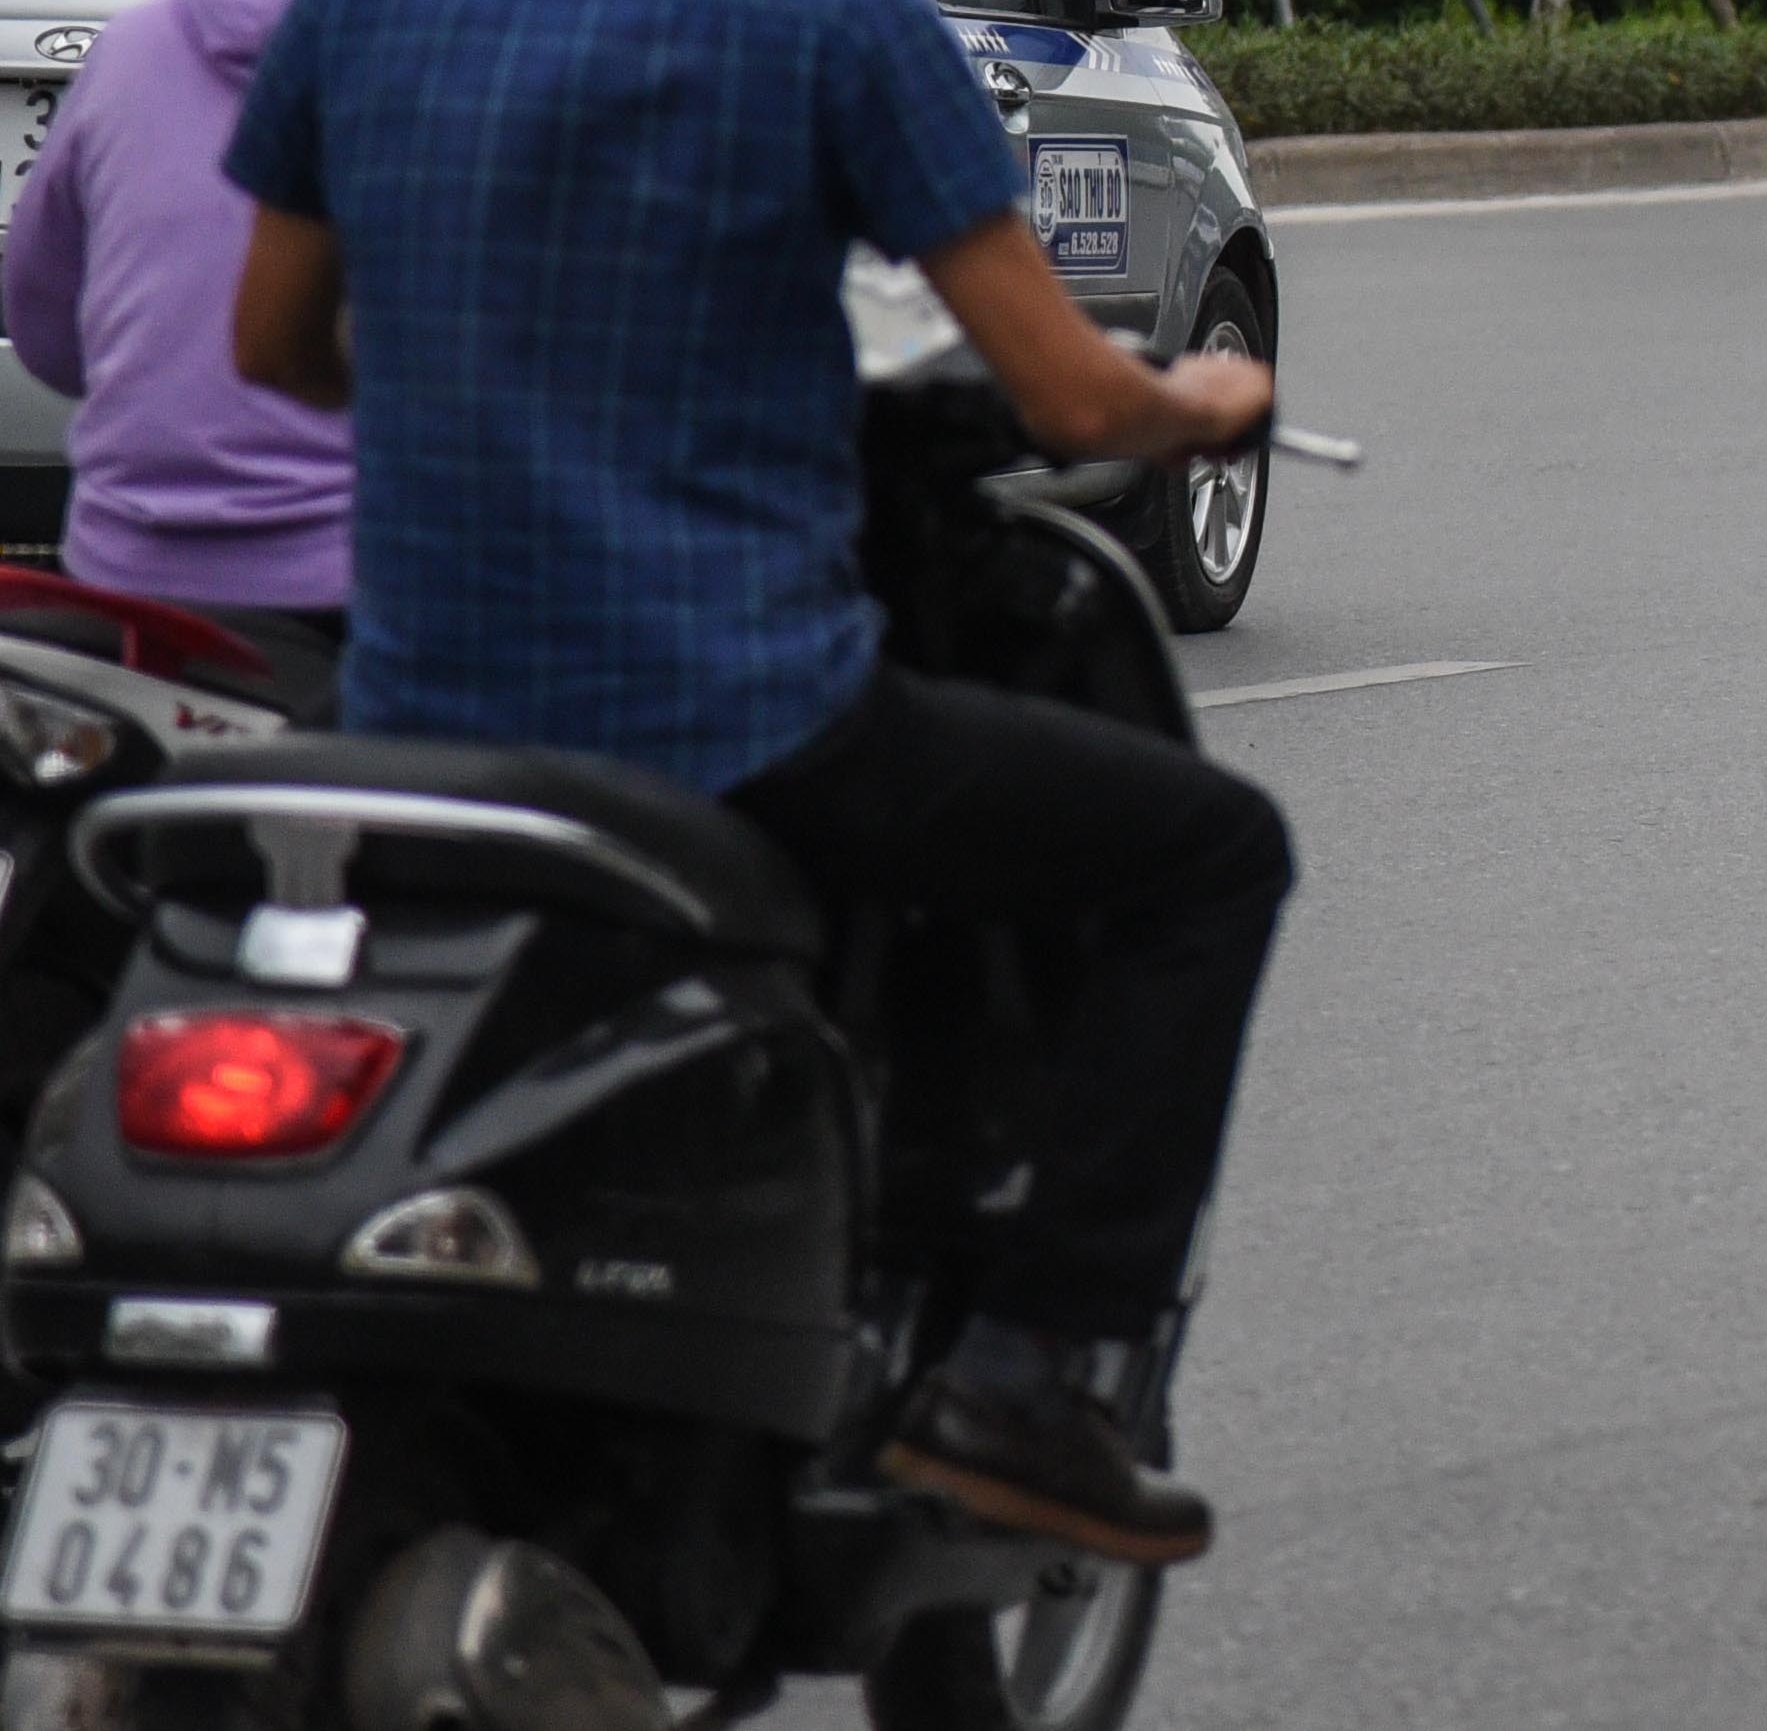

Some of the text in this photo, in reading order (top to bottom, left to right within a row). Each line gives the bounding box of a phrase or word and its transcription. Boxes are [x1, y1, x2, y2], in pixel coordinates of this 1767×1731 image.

[1059, 168, 1081, 219] SAO
[1083, 153, 1104, 219] THỦ
[1071, 231, 1119, 256] 6.528.528
[47, 1520, 268, 1612] 0486
